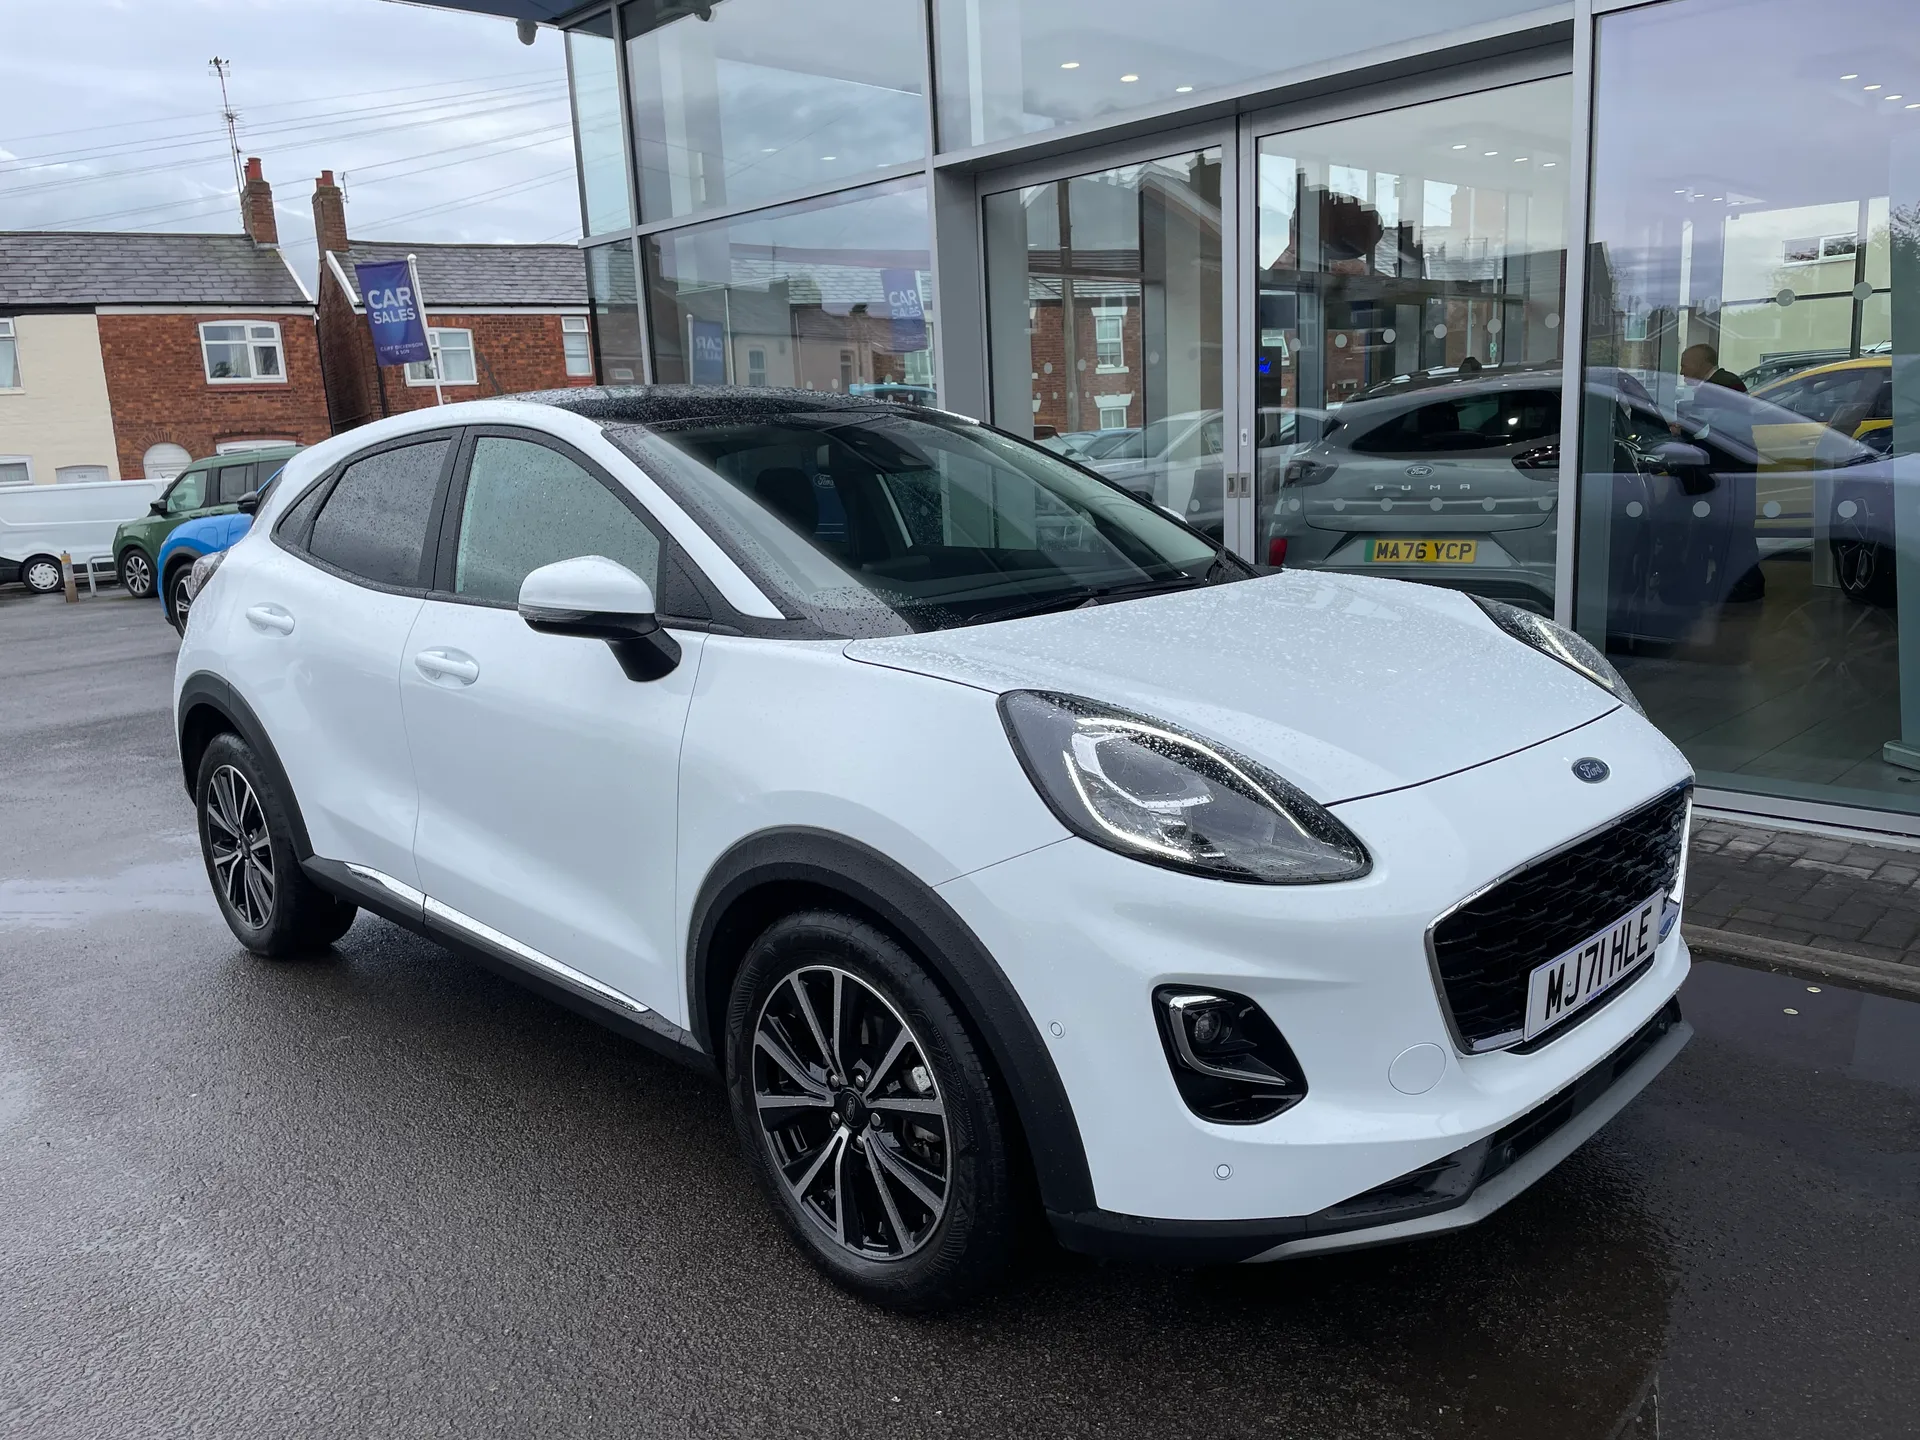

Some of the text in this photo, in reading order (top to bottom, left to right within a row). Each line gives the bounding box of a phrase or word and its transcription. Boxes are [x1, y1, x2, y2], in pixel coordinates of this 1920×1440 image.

[368, 287, 412, 309] CAR
[888, 289, 918, 307] CAR
[373, 308, 416, 324] SALES
[891, 306, 922, 320] SALES
[1410, 466, 1430, 476] Ford
[1374, 483, 1471, 491] PUMA
[1376, 542, 1473, 560] MA76 YCP
[1580, 762, 1603, 779] Ford
[1545, 905, 1652, 1021] MJ71 HLE
